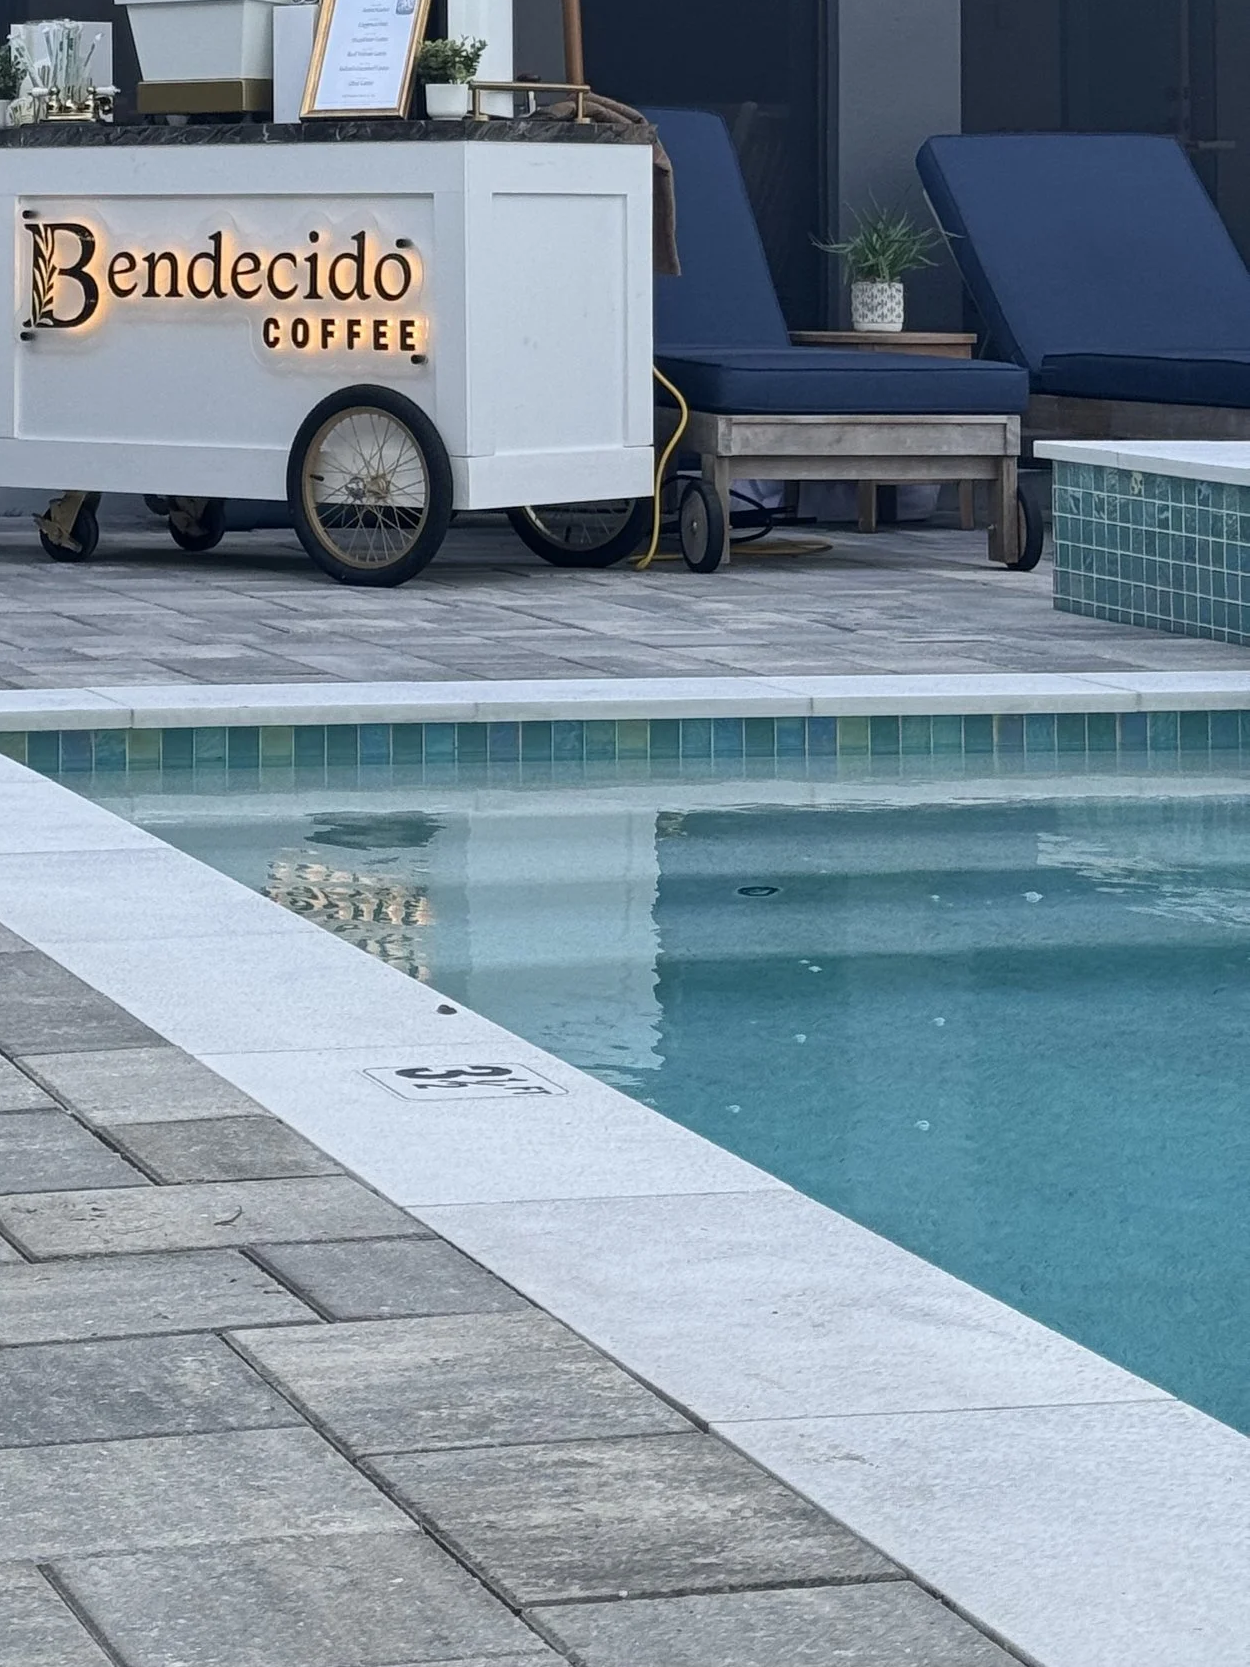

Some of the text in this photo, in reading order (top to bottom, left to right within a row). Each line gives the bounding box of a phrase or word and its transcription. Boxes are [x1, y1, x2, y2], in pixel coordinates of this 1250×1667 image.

[23, 222, 412, 329] Bendecido
[262, 317, 417, 351] COFFEE
[503, 1086, 552, 1095] FT
